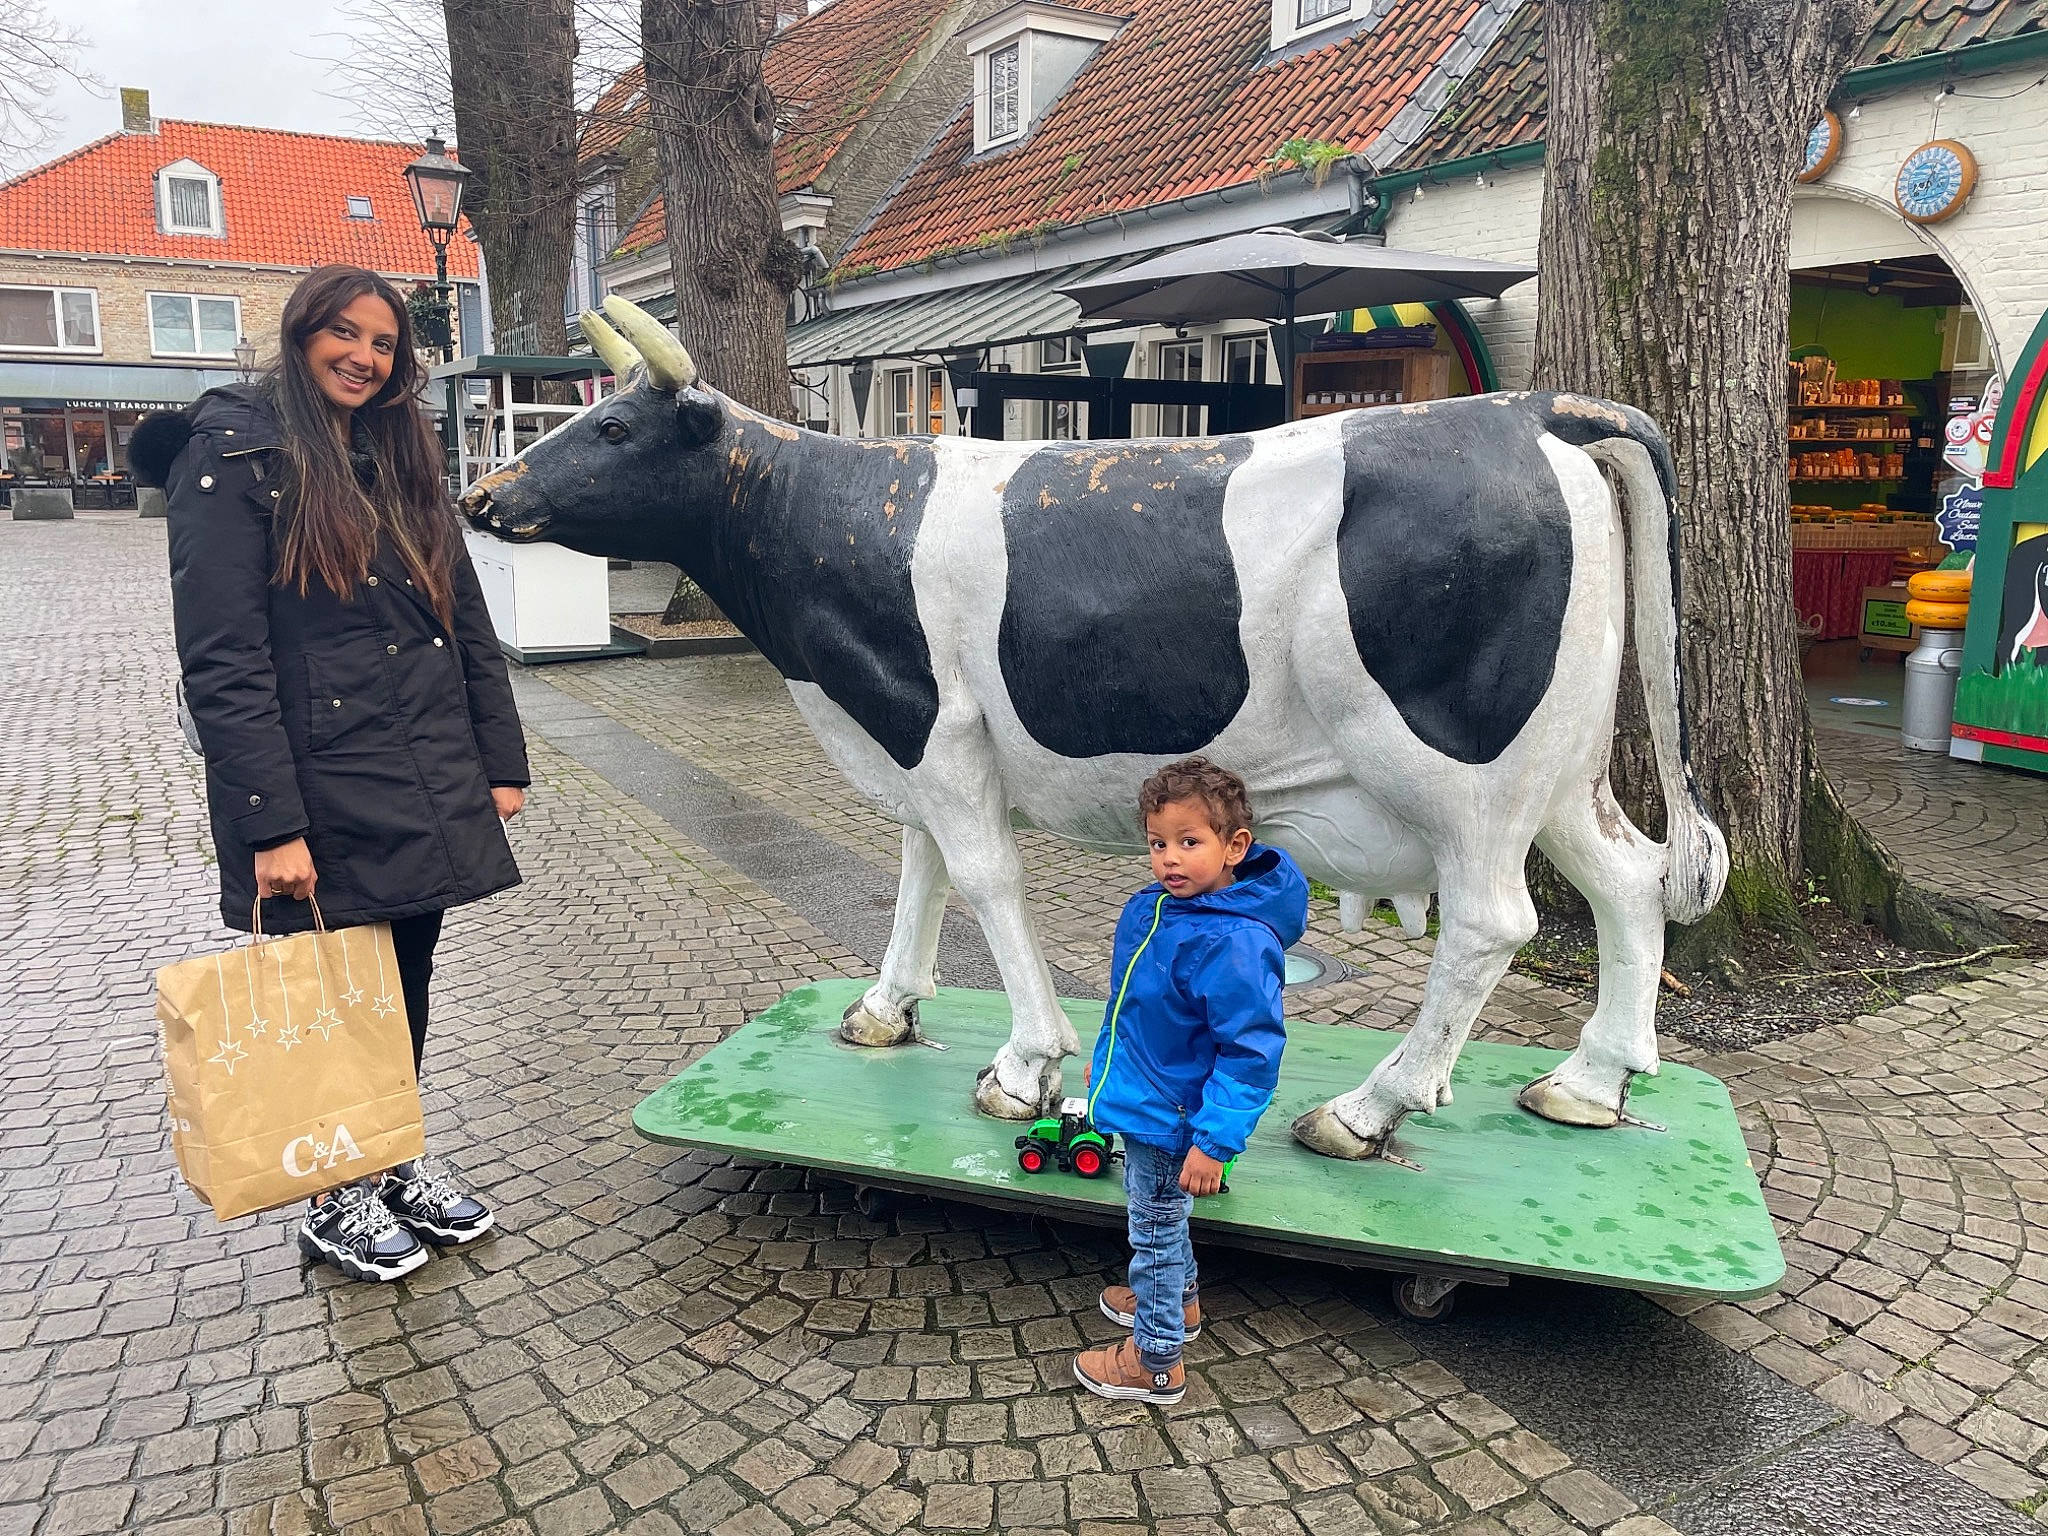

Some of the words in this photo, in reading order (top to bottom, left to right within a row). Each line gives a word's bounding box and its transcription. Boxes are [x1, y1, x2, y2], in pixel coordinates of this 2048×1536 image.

[66, 400, 102, 408] LUNCH
[113, 401, 165, 410] TEAROOM
[281, 1123, 366, 1178] C&A
